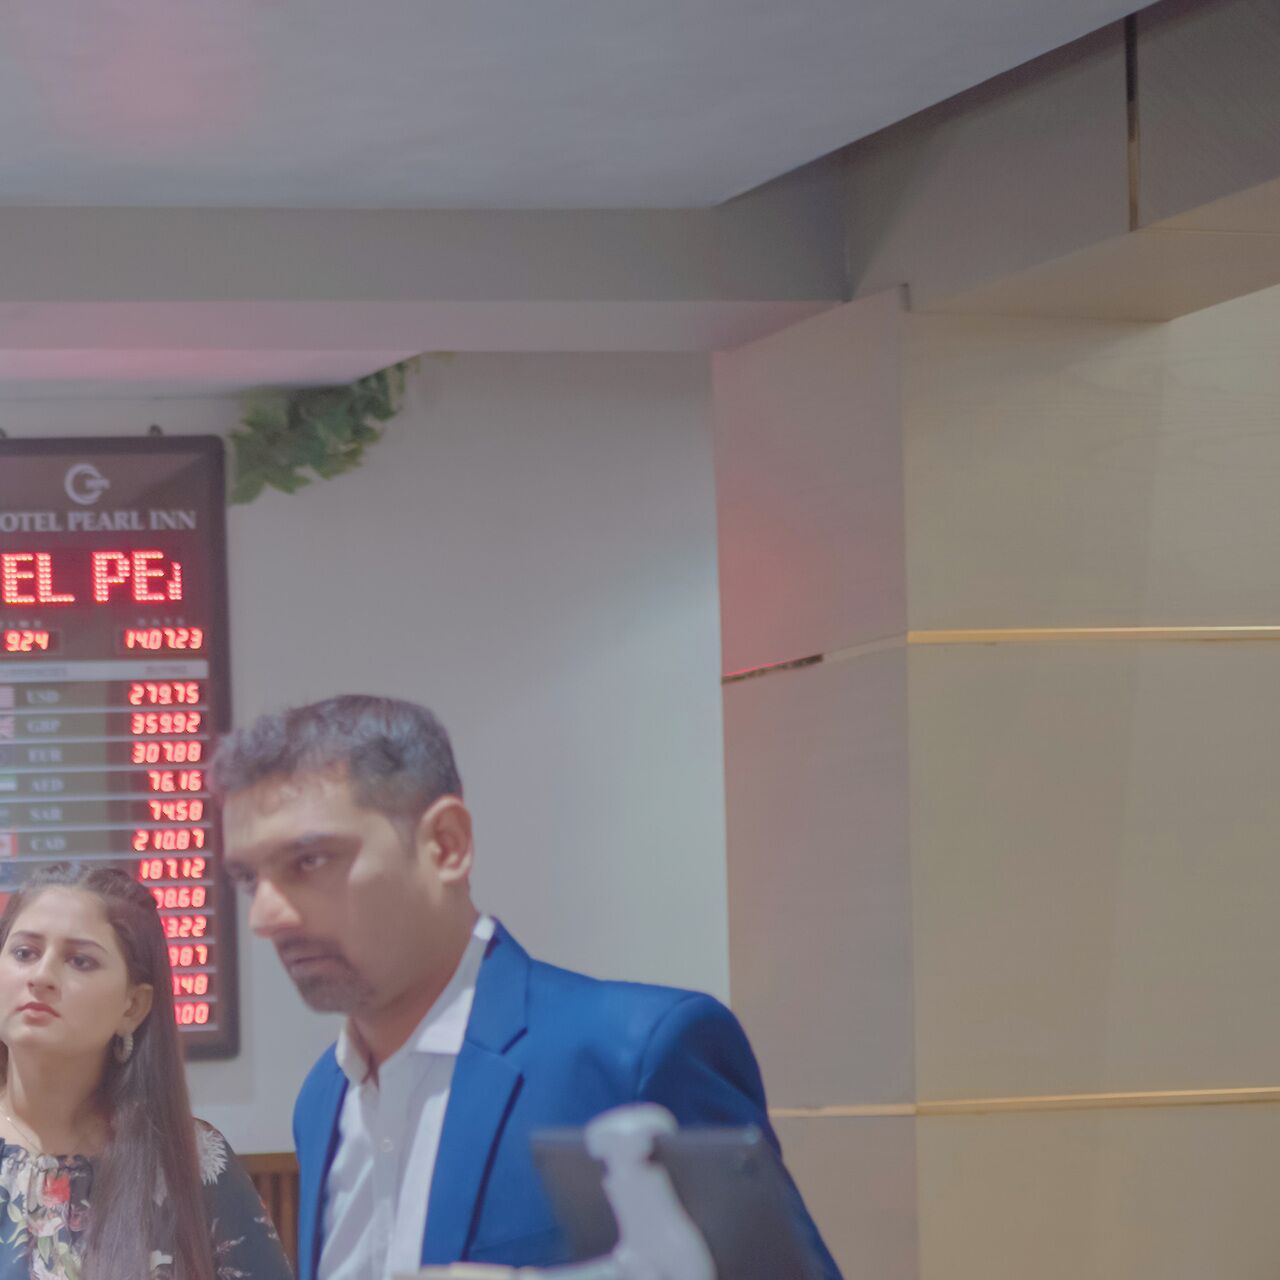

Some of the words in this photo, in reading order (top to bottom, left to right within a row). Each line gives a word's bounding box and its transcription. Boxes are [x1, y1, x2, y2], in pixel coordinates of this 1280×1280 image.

[67, 511, 144, 532] PEARL
[149, 509, 196, 531] INN
[0, 551, 76, 605] EL
